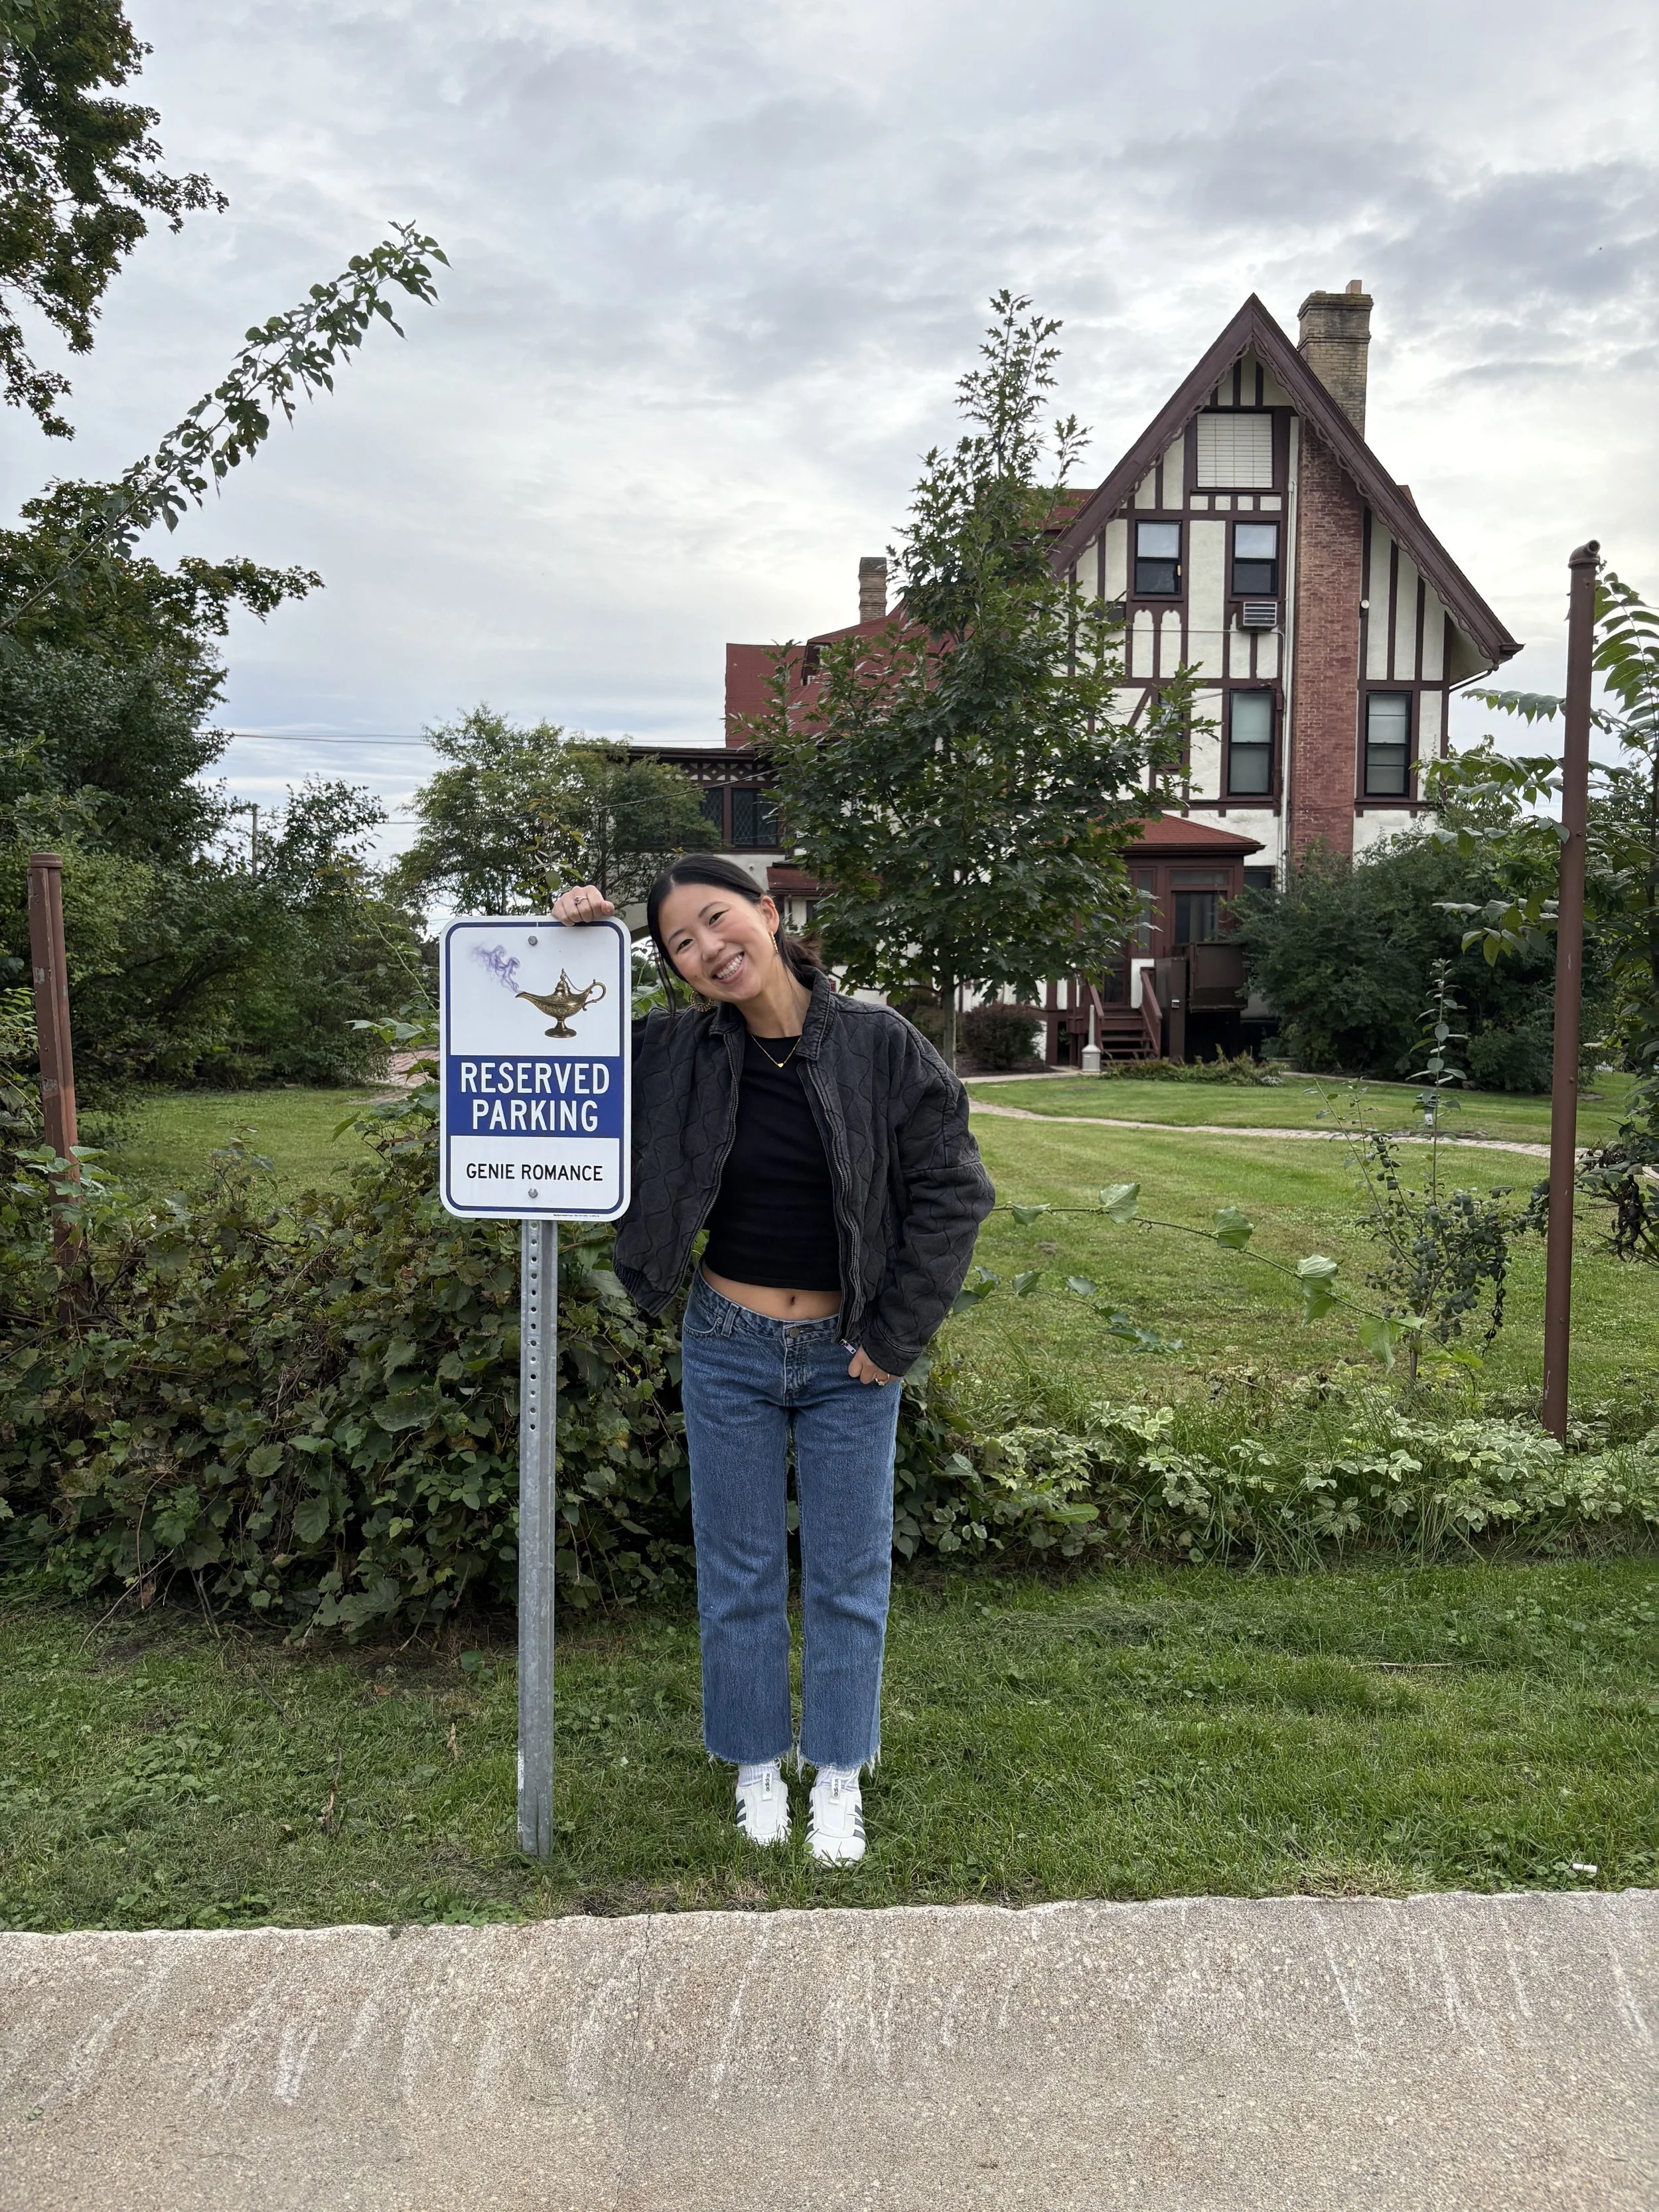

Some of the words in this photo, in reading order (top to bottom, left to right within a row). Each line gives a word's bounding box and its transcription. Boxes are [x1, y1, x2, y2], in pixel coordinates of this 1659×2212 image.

[461, 1062, 610, 1094] RESERVED
[472, 1099, 598, 1132] PARKING
[466, 1163, 515, 1179] GENIE
[522, 1164, 603, 1181] ROMANCE
